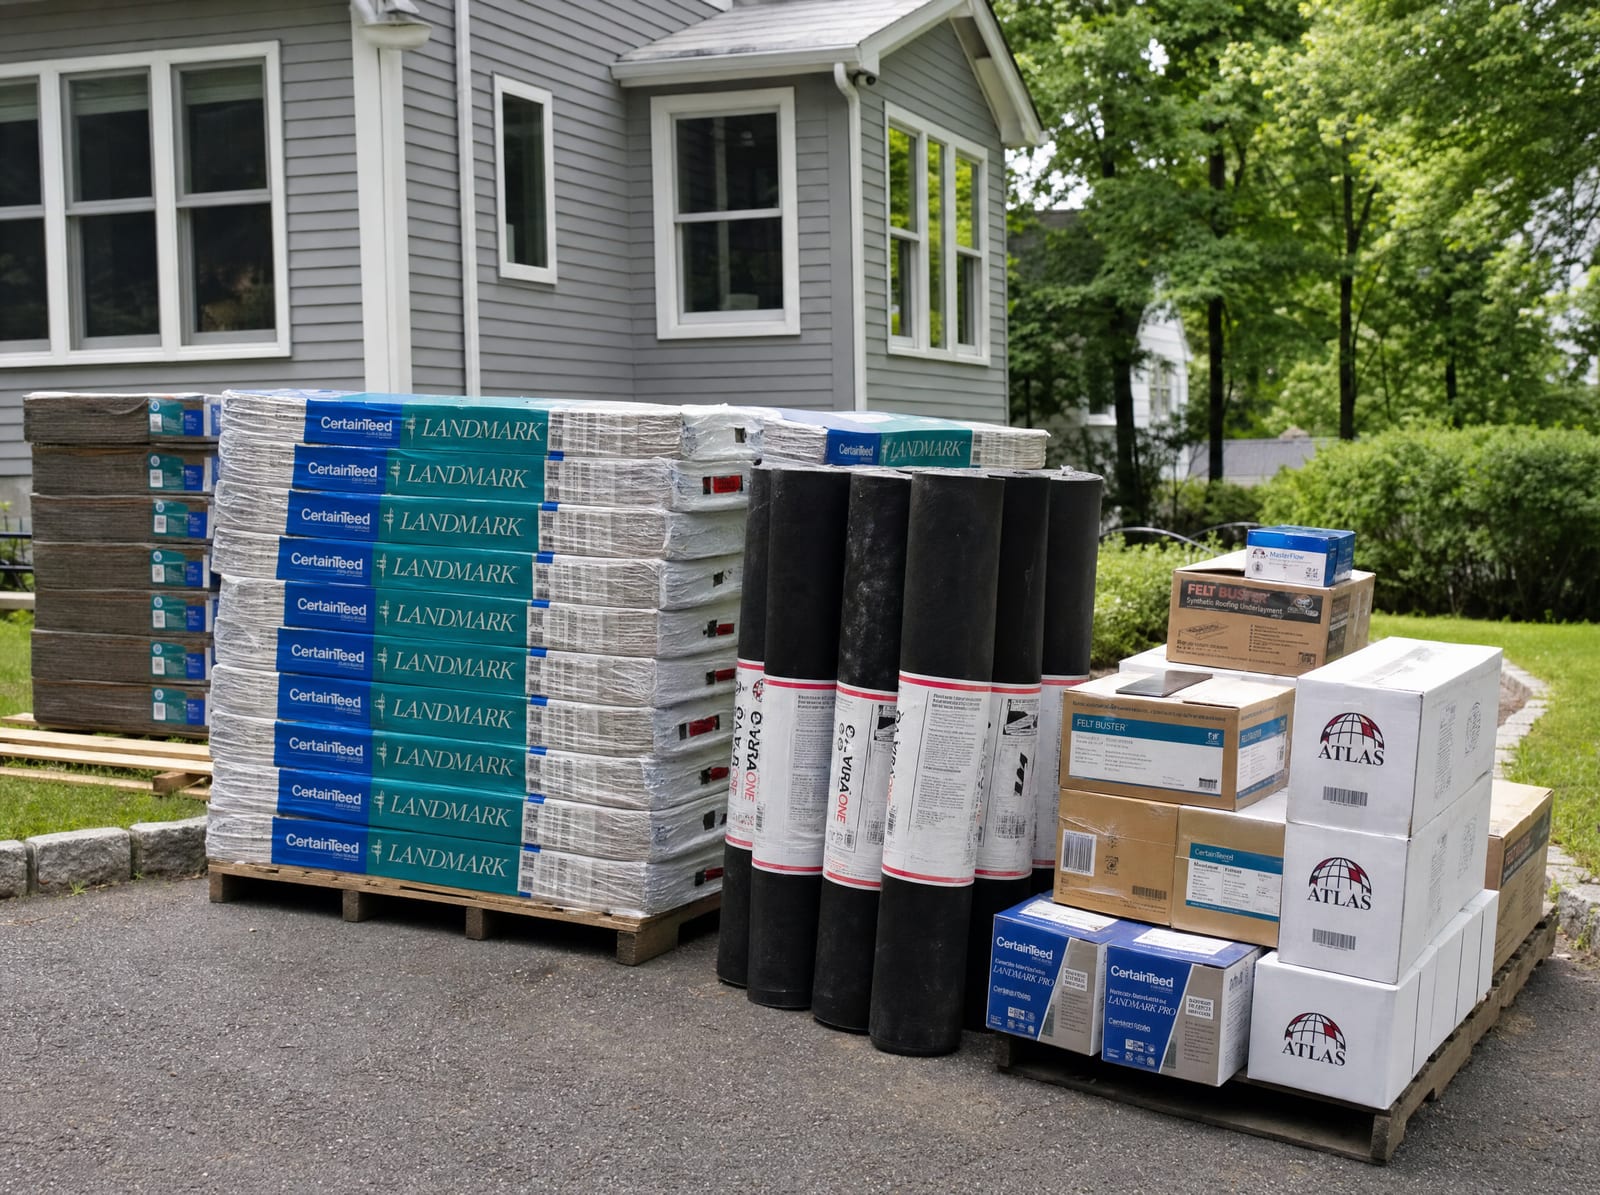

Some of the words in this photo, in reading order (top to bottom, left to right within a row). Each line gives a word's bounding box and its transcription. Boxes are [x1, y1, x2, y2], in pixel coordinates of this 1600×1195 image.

[320, 416, 393, 432] CertainTeed
[422, 418, 542, 441] LANDMARK
[891, 441, 962, 461] LANDMARK
[308, 462, 378, 478] CertainTeed
[406, 464, 527, 488] LANDMARK
[301, 508, 370, 525] CertainTeed
[400, 512, 521, 536] LANDMARK
[291, 552, 363, 570] CertainTeed
[1269, 551, 1305, 561] MasterFlow
[393, 558, 516, 584] LANDMARK
[1187, 583, 1216, 597] FELT
[297, 598, 367, 616] CertainTeed
[1186, 597, 1214, 606] Synthetic
[1215, 600, 1239, 610] Roofing
[1240, 602, 1283, 615] Underlayment
[396, 604, 515, 632] LANDMARK
[291, 644, 365, 663] CertainTeed
[394, 651, 514, 680] LANDMARK
[289, 688, 361, 708] CertainTeed
[393, 699, 513, 729] LANDMARK
[1076, 718, 1094, 728] FELT
[1095, 721, 1126, 732] BUSTER
[289, 737, 363, 757] CertainTeed
[1317, 743, 1385, 767] ATLAS
[394, 747, 514, 776] LANDMARK
[292, 784, 362, 805] CertainTeed
[390, 795, 509, 827] LANDMARK
[286, 833, 359, 854] CertainTeed
[388, 844, 507, 877] LANDMARK
[1306, 887, 1372, 911] ATLAS
[996, 936, 1053, 960] CertainTeed
[992, 965, 1037, 984] LANDMARK
[1037, 976, 1055, 987] PRO
[1110, 965, 1174, 987] CertainTeed
[1107, 996, 1157, 1013] LANDMARK
[1158, 1005, 1176, 1016] PRO
[1281, 1041, 1346, 1067] ATLAS
